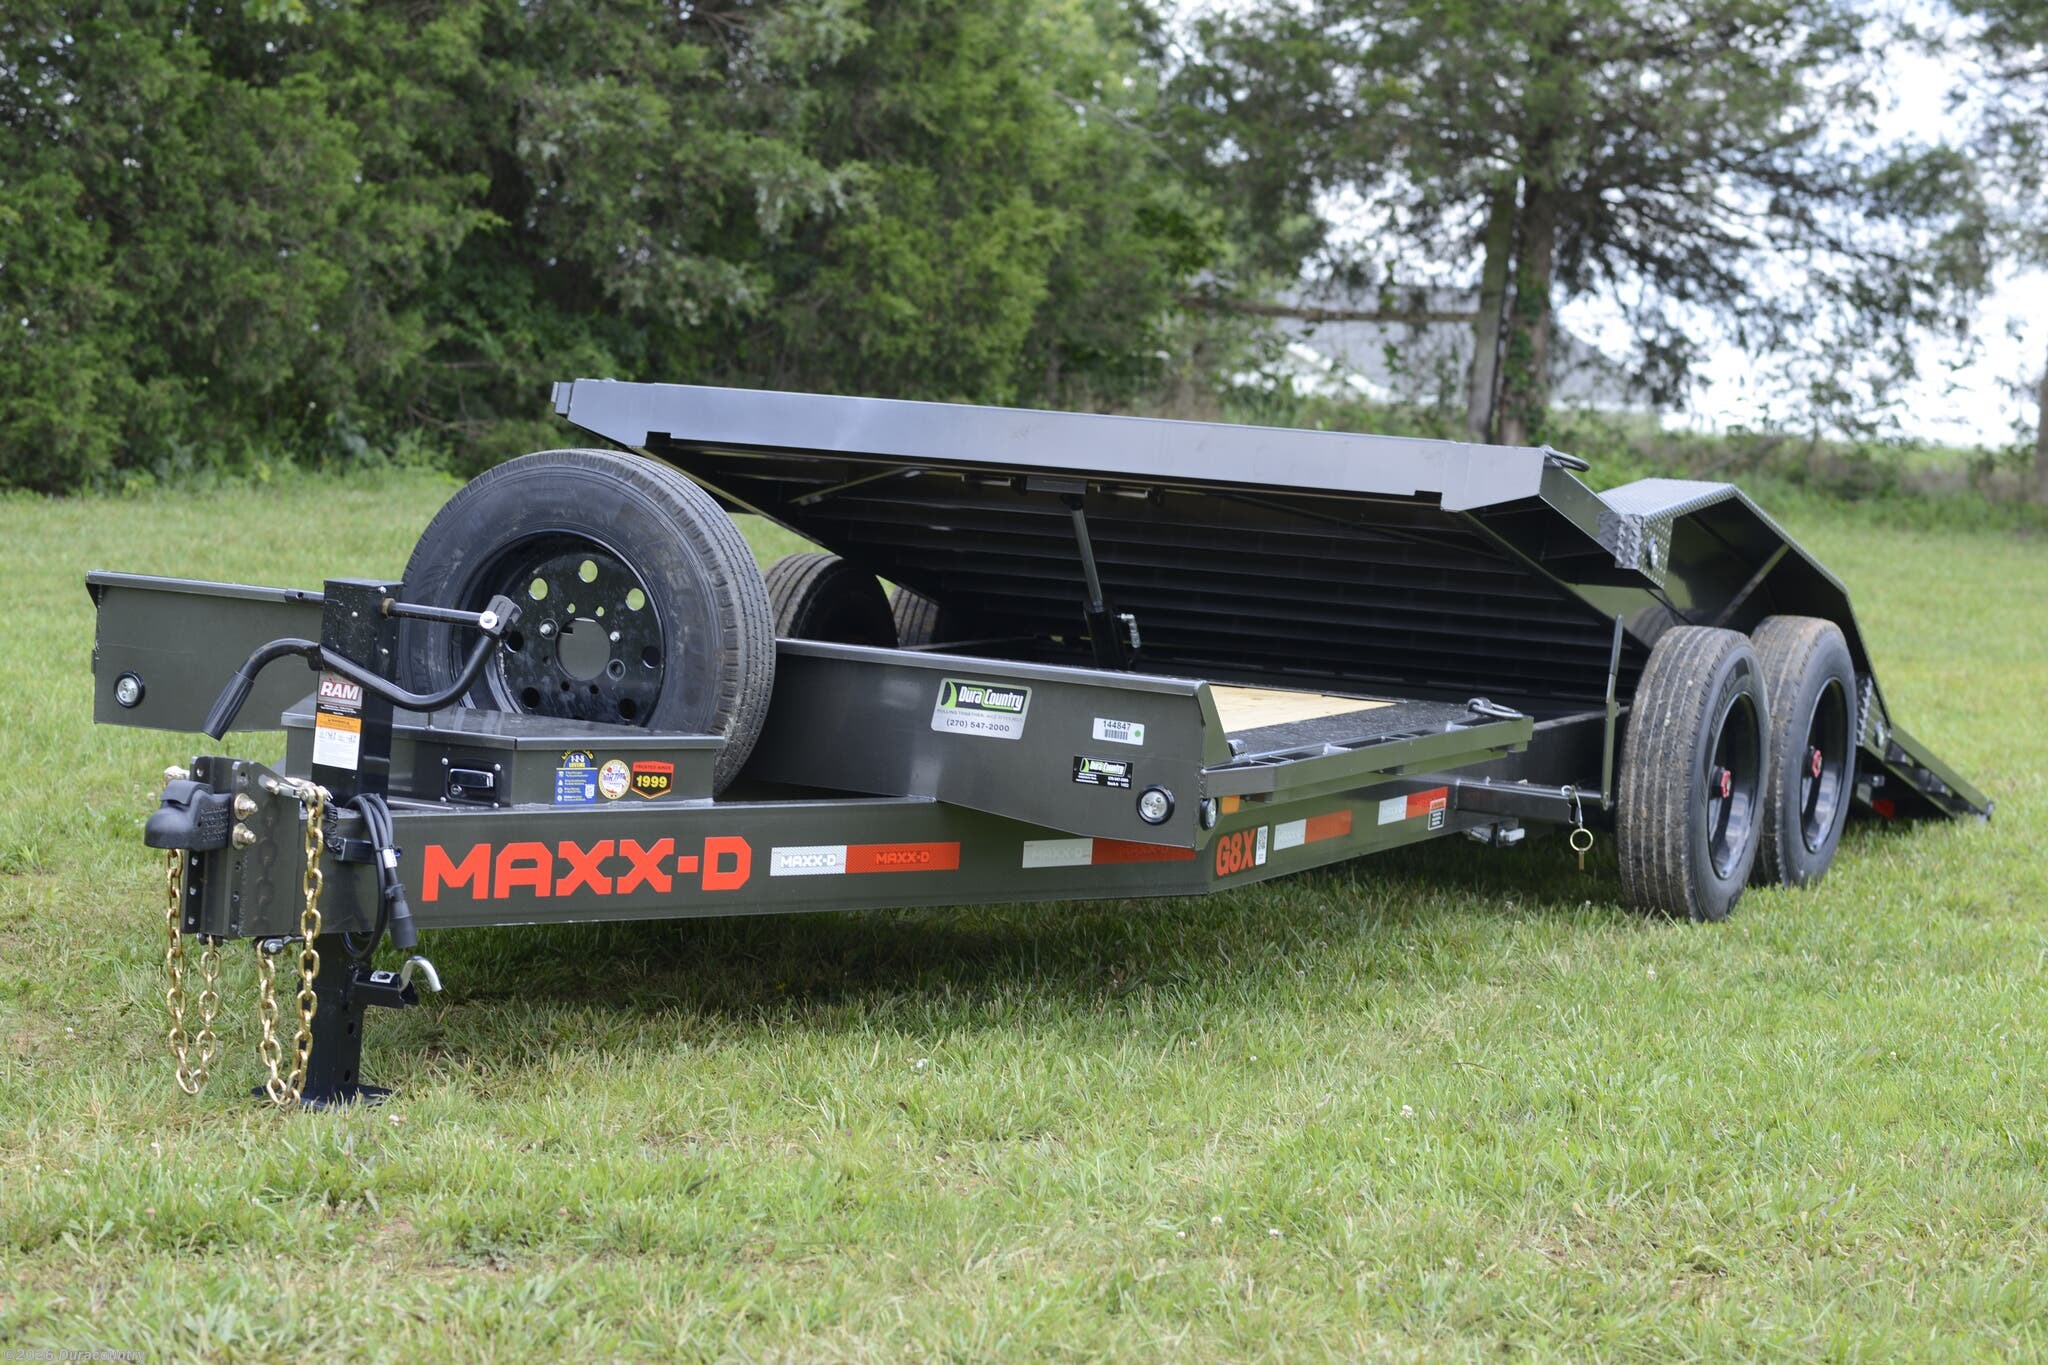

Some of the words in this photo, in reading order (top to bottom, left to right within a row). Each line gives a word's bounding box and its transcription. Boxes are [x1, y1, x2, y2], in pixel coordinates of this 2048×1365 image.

[320, 681, 360, 700] RAM
[958, 686, 982, 704] Dura
[984, 688, 1024, 711] Country
[946, 719, 967, 729] (270)
[970, 722, 1010, 732] 547-2000
[1103, 720, 1131, 731] 144847
[1090, 761, 1104, 771] Dura
[1104, 762, 1125, 775] Country
[636, 775, 667, 788] 1999
[781, 854, 836, 868] MAXX-D
[875, 851, 930, 865] MAXX-D
[1216, 828, 1256, 876] G8X
[422, 836, 751, 902] MAXX-D
